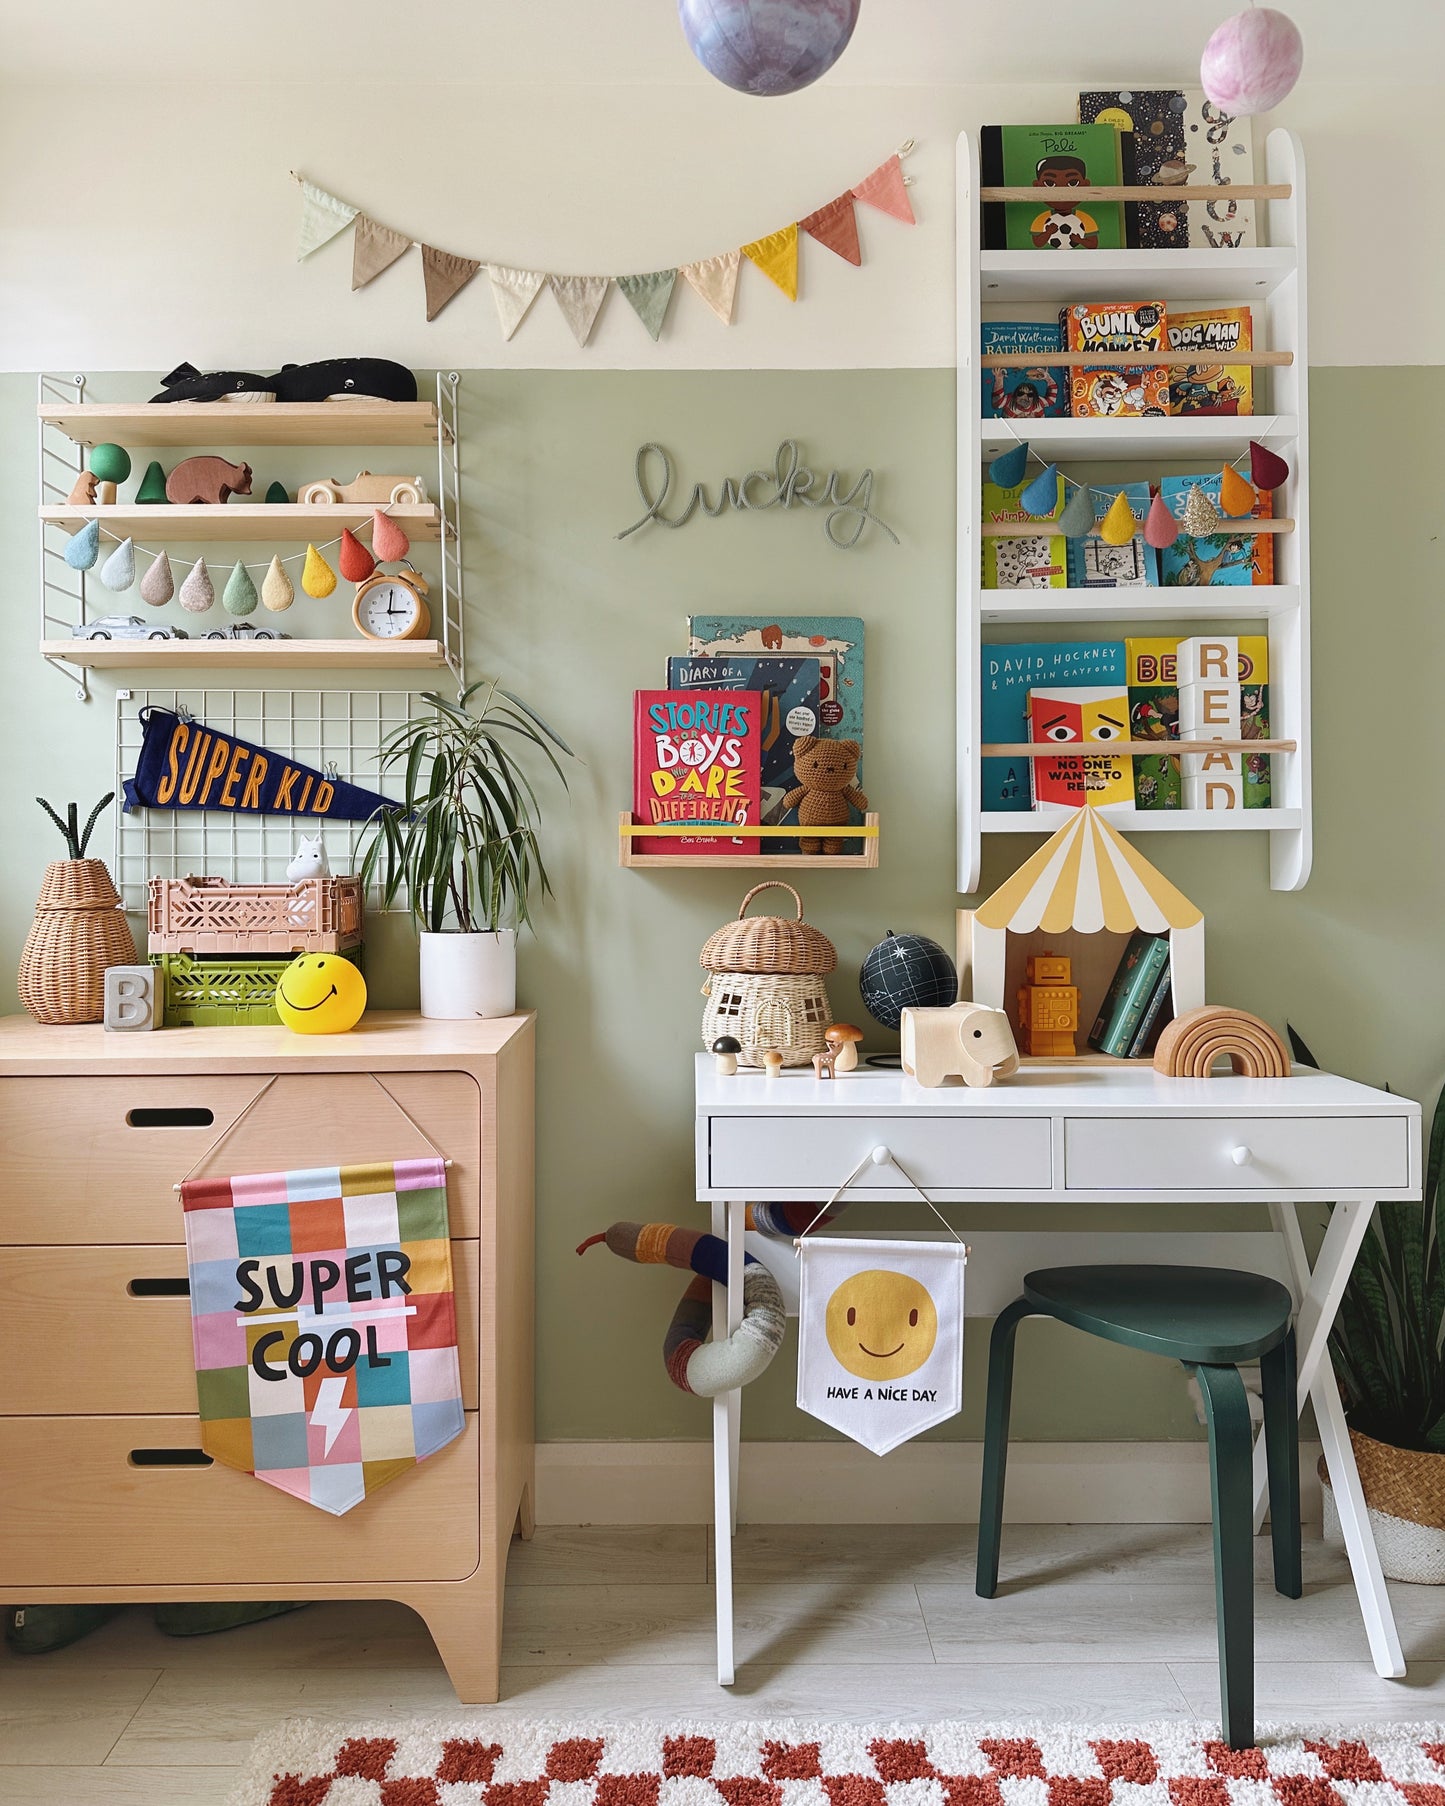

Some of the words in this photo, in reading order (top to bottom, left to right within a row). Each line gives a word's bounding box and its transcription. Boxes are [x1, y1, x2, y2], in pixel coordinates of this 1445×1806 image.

[1040, 137, 1078, 153] Pelé
[984, 331, 1017, 345] David
[1018, 332, 1059, 343] Walliams
[1167, 325, 1203, 347] DOG
[1205, 322, 1240, 342] MAN
[985, 345, 1058, 355] RATBURGER
[613, 439, 900, 549] lucky
[990, 510, 1031, 523] Wimpy
[721, 667, 734, 677] OF
[736, 669, 742, 677] A
[990, 657, 1044, 676] DAVID
[1053, 648, 1117, 665] HOCKNEY
[991, 680, 998, 690] &
[1006, 671, 1057, 686] MARTIN
[1063, 664, 1116, 677] GAYFORD
[655, 733, 742, 774] BOYS
[1057, 760, 1079, 770] NO
[1081, 760, 1112, 770] ONE
[157, 723, 269, 809] SUPER
[273, 765, 335, 813] KID
[1102, 771, 1122, 780] TO
[651, 765, 748, 799] DARE
[649, 797, 751, 825] DIFFERENT
[108, 972, 153, 1029] B
[233, 1250, 413, 1315] SUPER
[252, 1325, 392, 1382] COOL
[827, 1386, 859, 1400] HAVE
[864, 1388, 873, 1400] A
